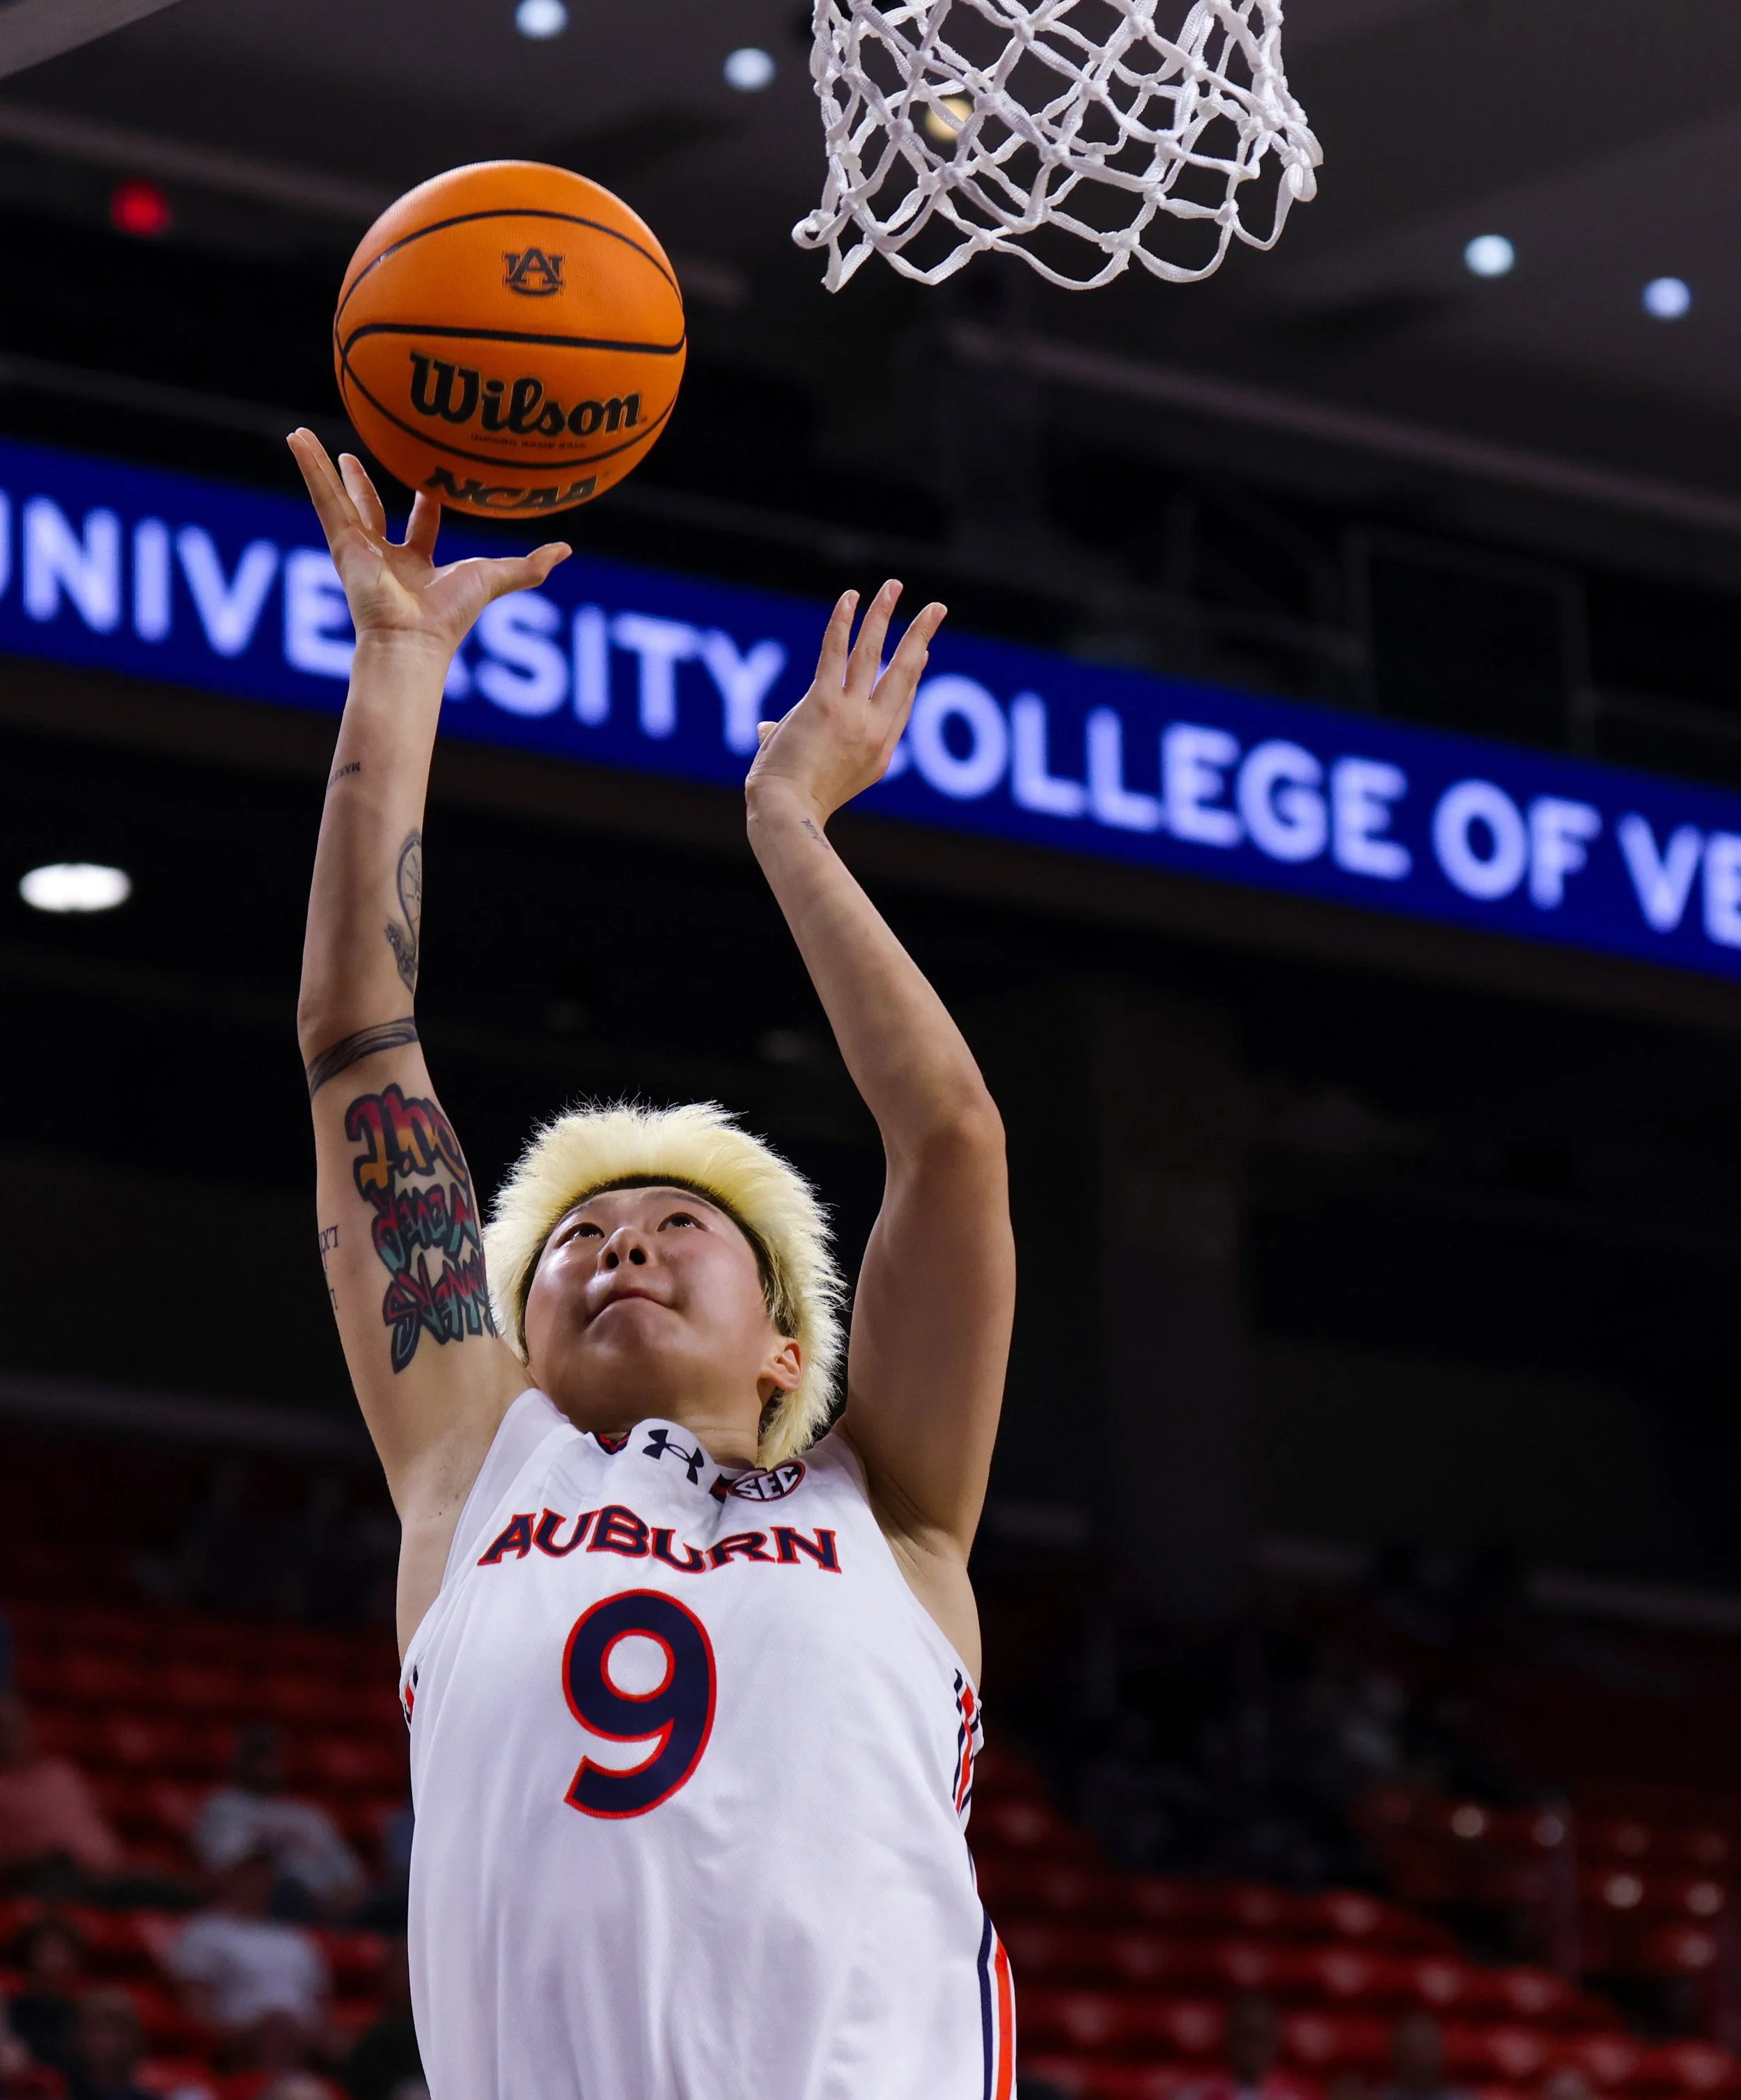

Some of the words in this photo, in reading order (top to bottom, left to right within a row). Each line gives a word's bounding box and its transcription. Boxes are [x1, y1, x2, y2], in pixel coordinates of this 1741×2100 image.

[409, 350, 641, 437] Wilson
[424, 466, 598, 510] NCAA
[0, 490, 787, 754] NIVESITY
[876, 665, 1411, 880] OLLEGE
[1432, 778, 1602, 910] OF
[735, 1465, 799, 1500] SEC
[477, 1505, 842, 1573] AUBURN
[561, 1588, 717, 1819] 9
